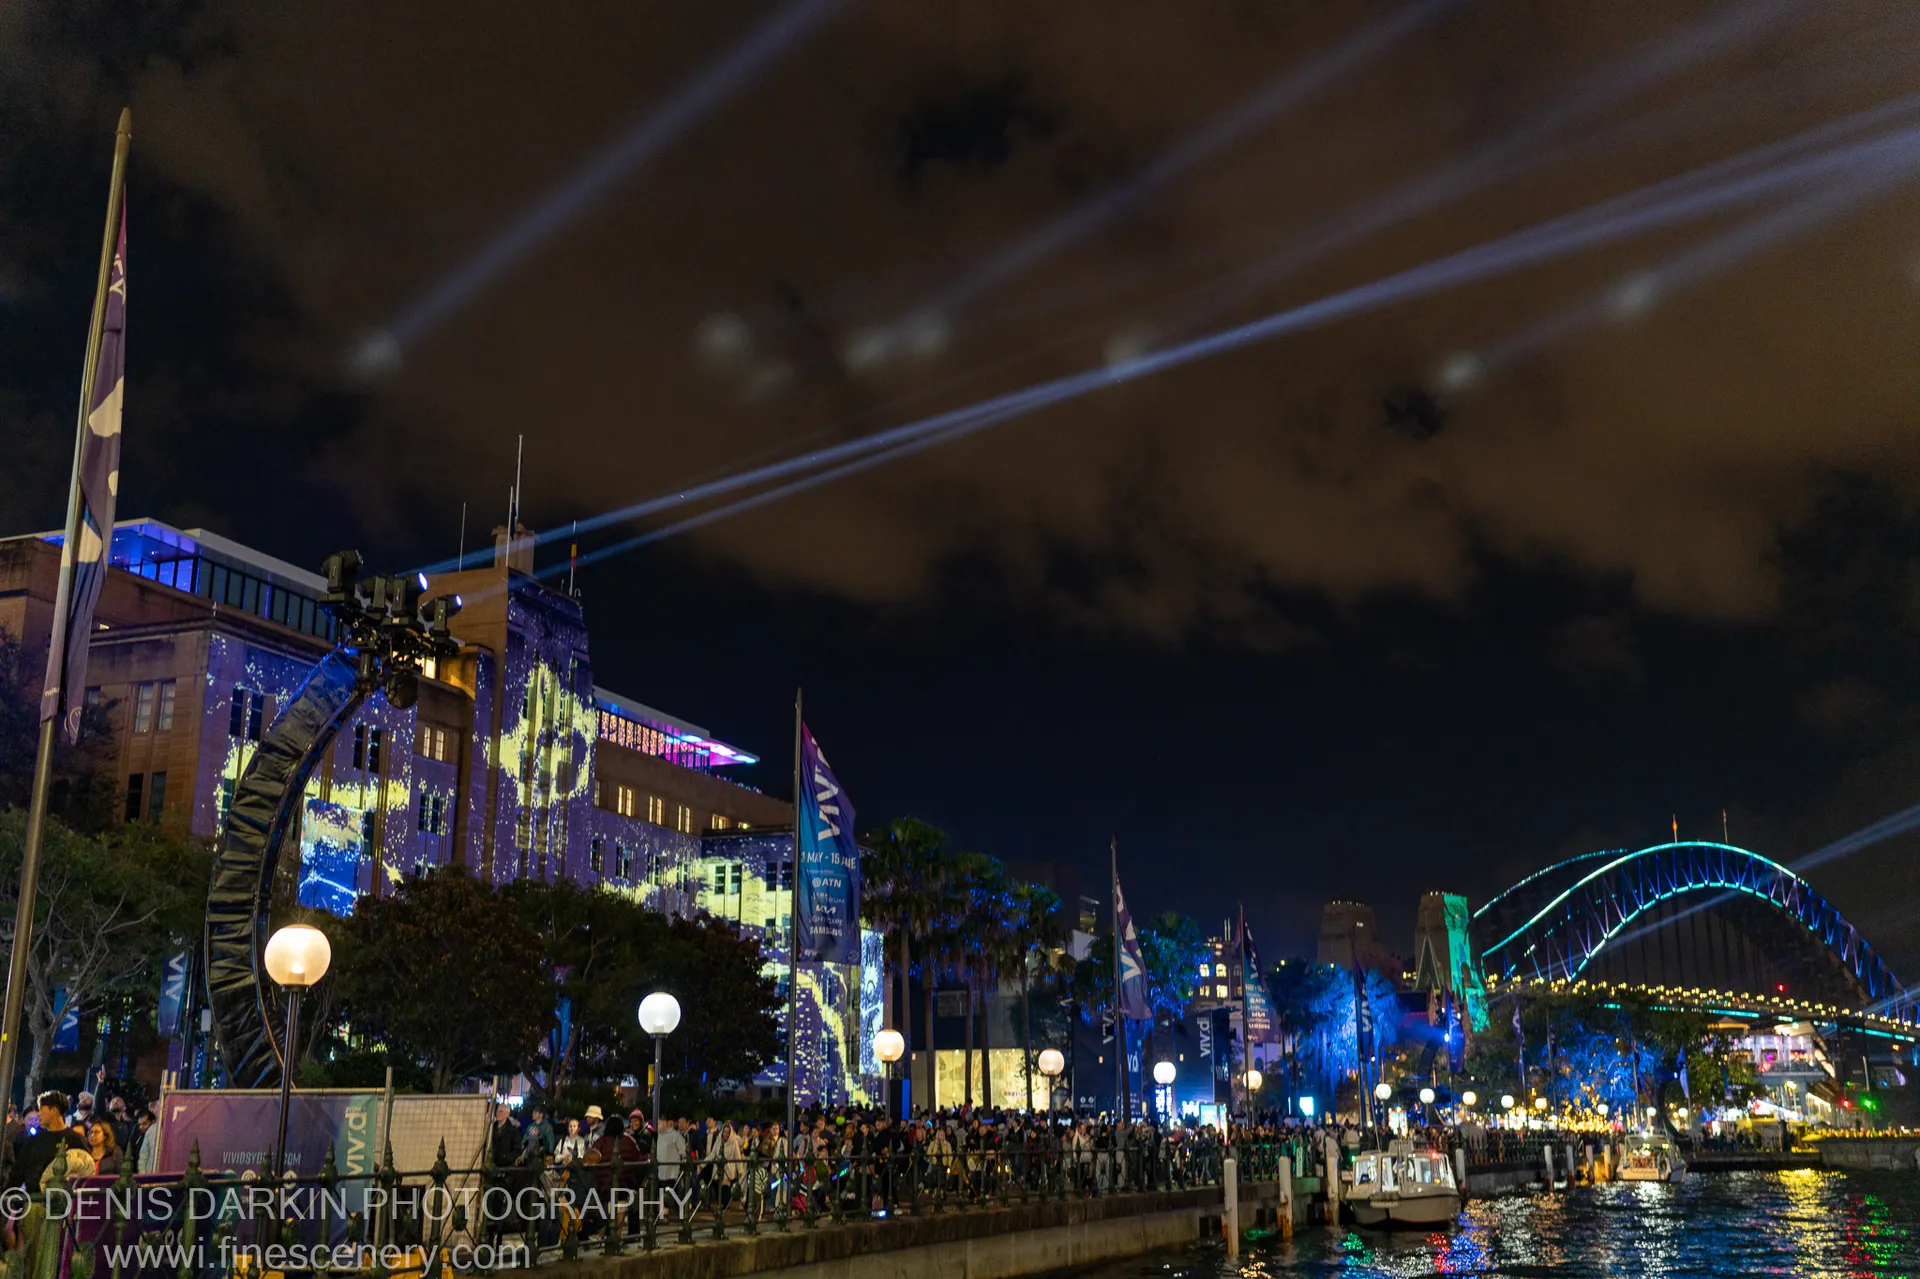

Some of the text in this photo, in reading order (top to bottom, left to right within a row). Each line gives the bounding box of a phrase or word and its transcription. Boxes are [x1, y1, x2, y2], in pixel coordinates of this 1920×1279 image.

[807, 851, 823, 863] MAY
[809, 926, 842, 937] SAMNG
[223, 1152, 302, 1164] VIVIDSYDOM
